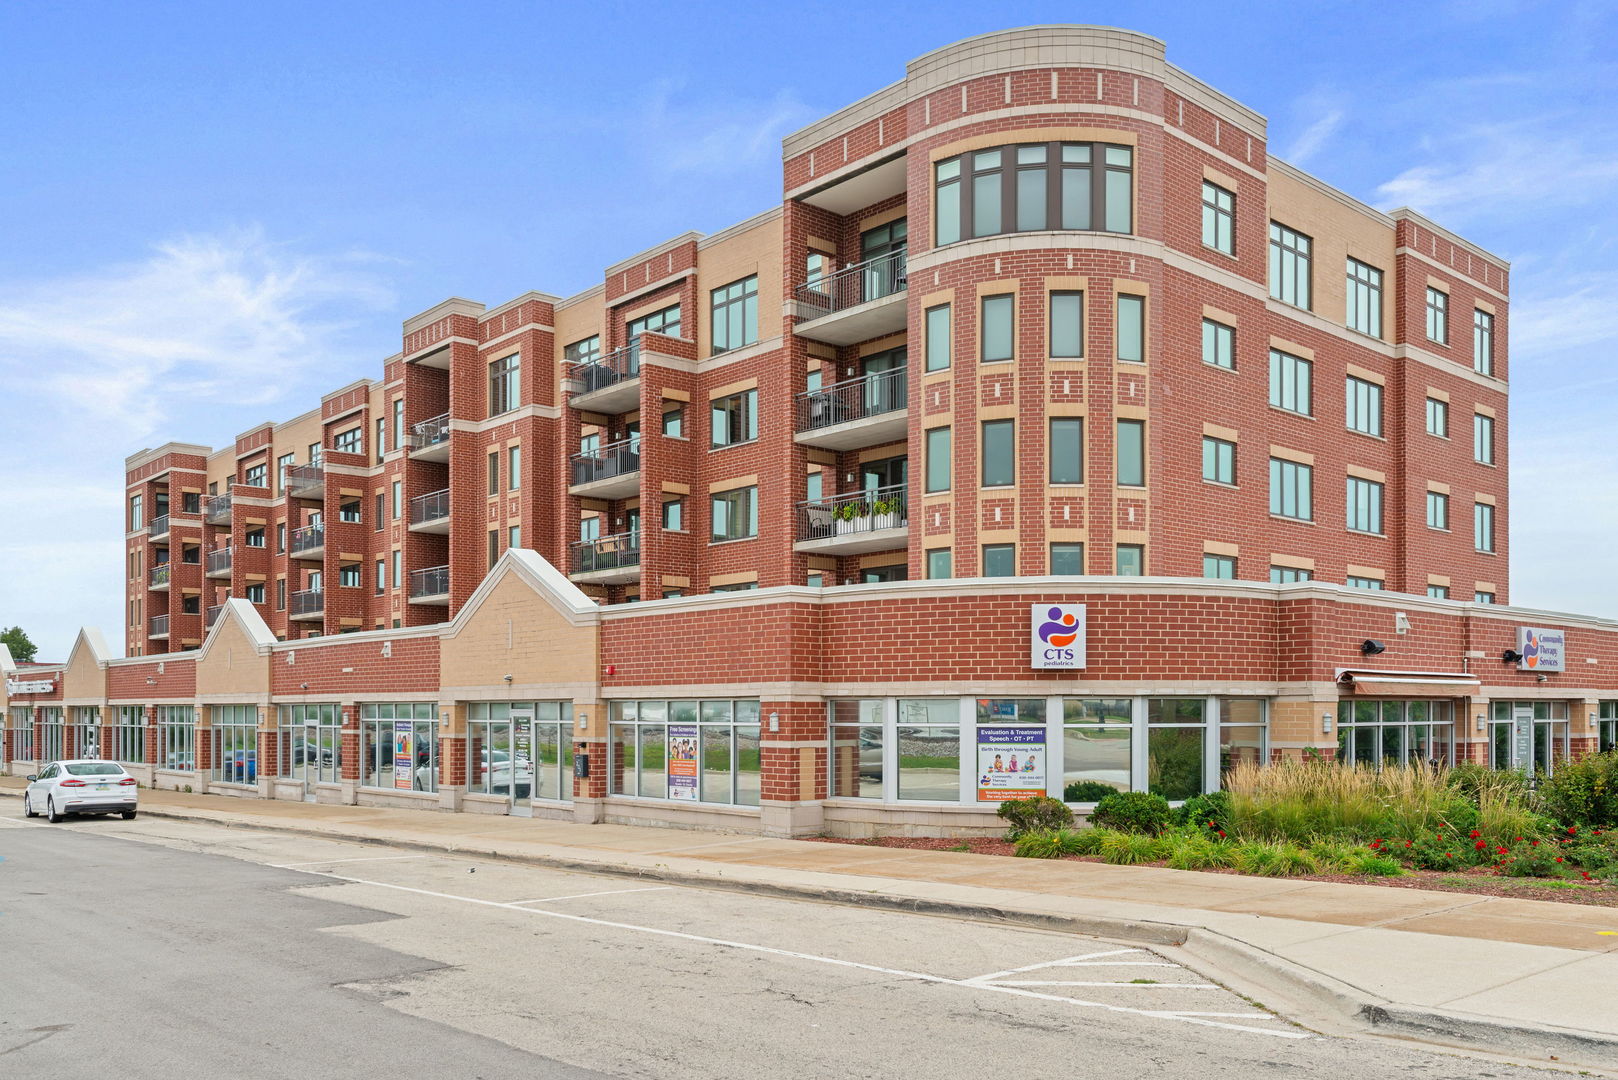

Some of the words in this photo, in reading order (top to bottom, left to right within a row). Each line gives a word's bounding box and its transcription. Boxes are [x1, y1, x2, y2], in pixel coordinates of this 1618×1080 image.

[1538, 634, 1563, 646] Community
[1044, 648, 1074, 660] CTS
[1540, 645, 1558, 657] Therapy
[1540, 656, 1558, 666] Services
